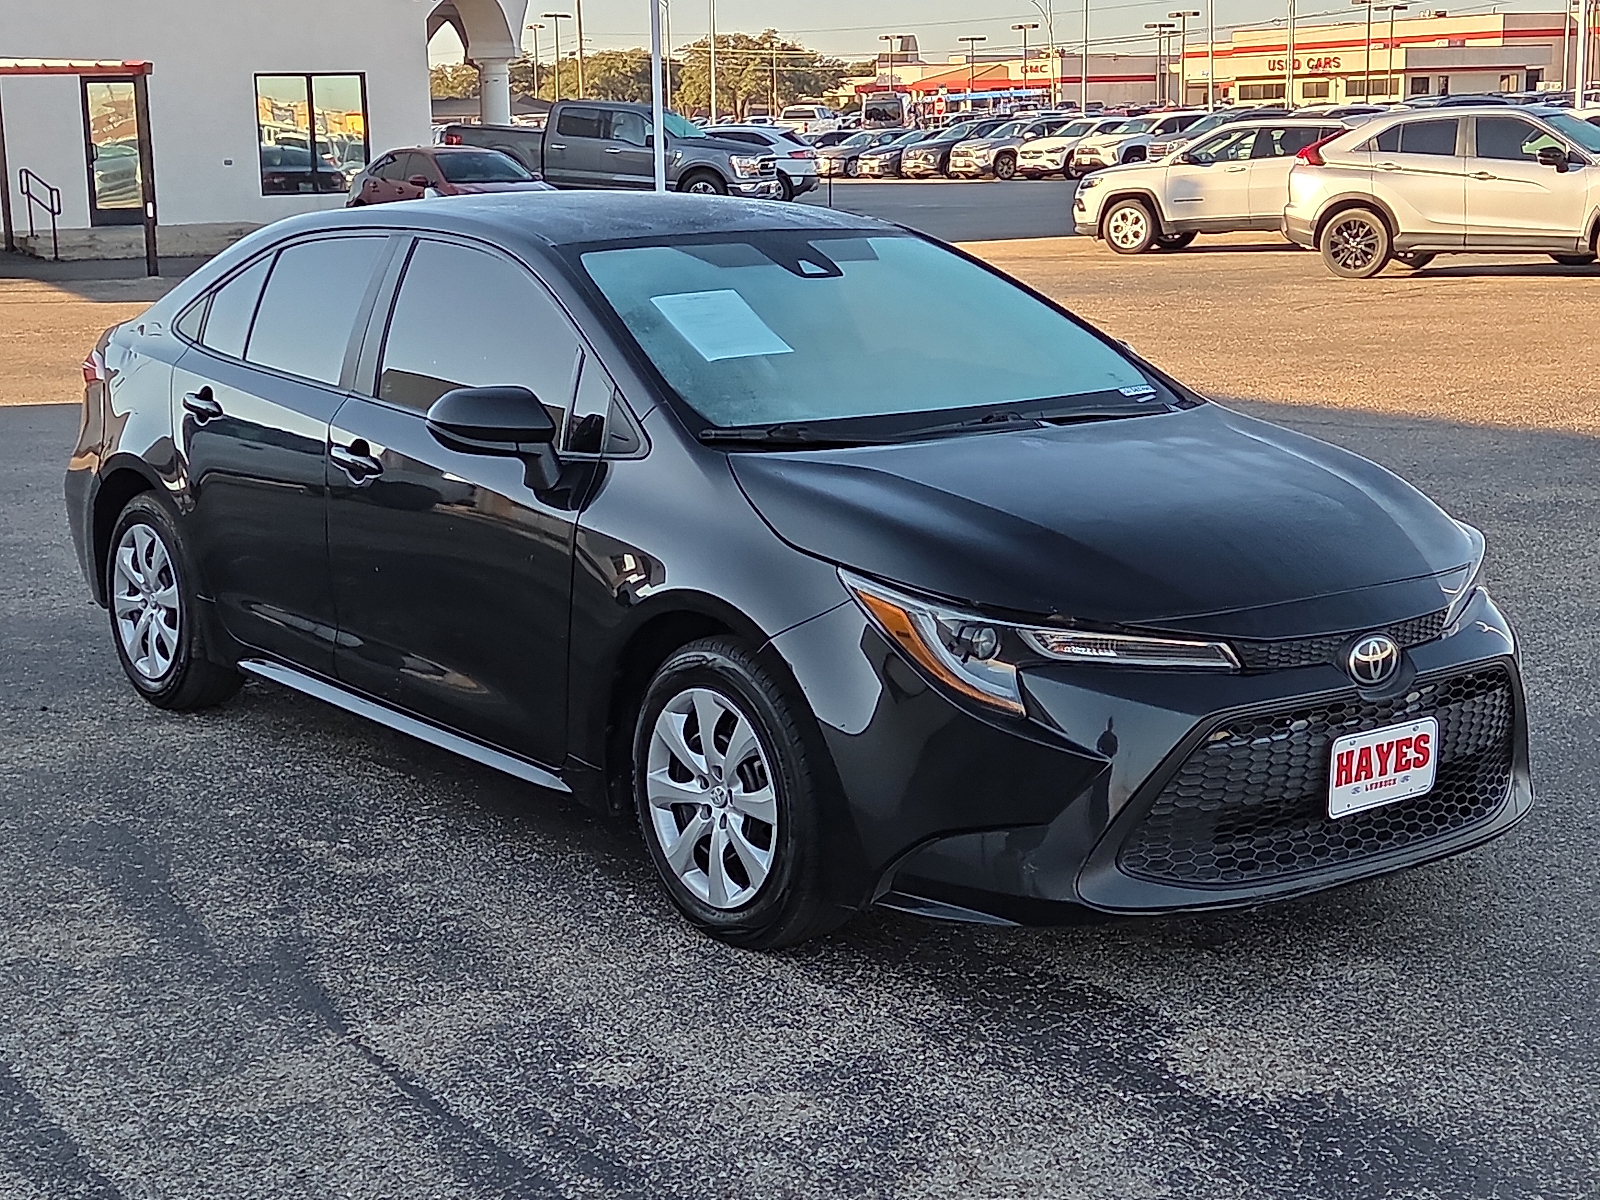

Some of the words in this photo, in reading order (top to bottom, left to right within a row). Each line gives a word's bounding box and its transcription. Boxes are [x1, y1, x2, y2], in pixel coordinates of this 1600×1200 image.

[1021, 65, 1048, 73] GMC
[1268, 58, 1302, 71] USD
[1306, 57, 1341, 69] CARS
[1335, 733, 1430, 787] HAYES
